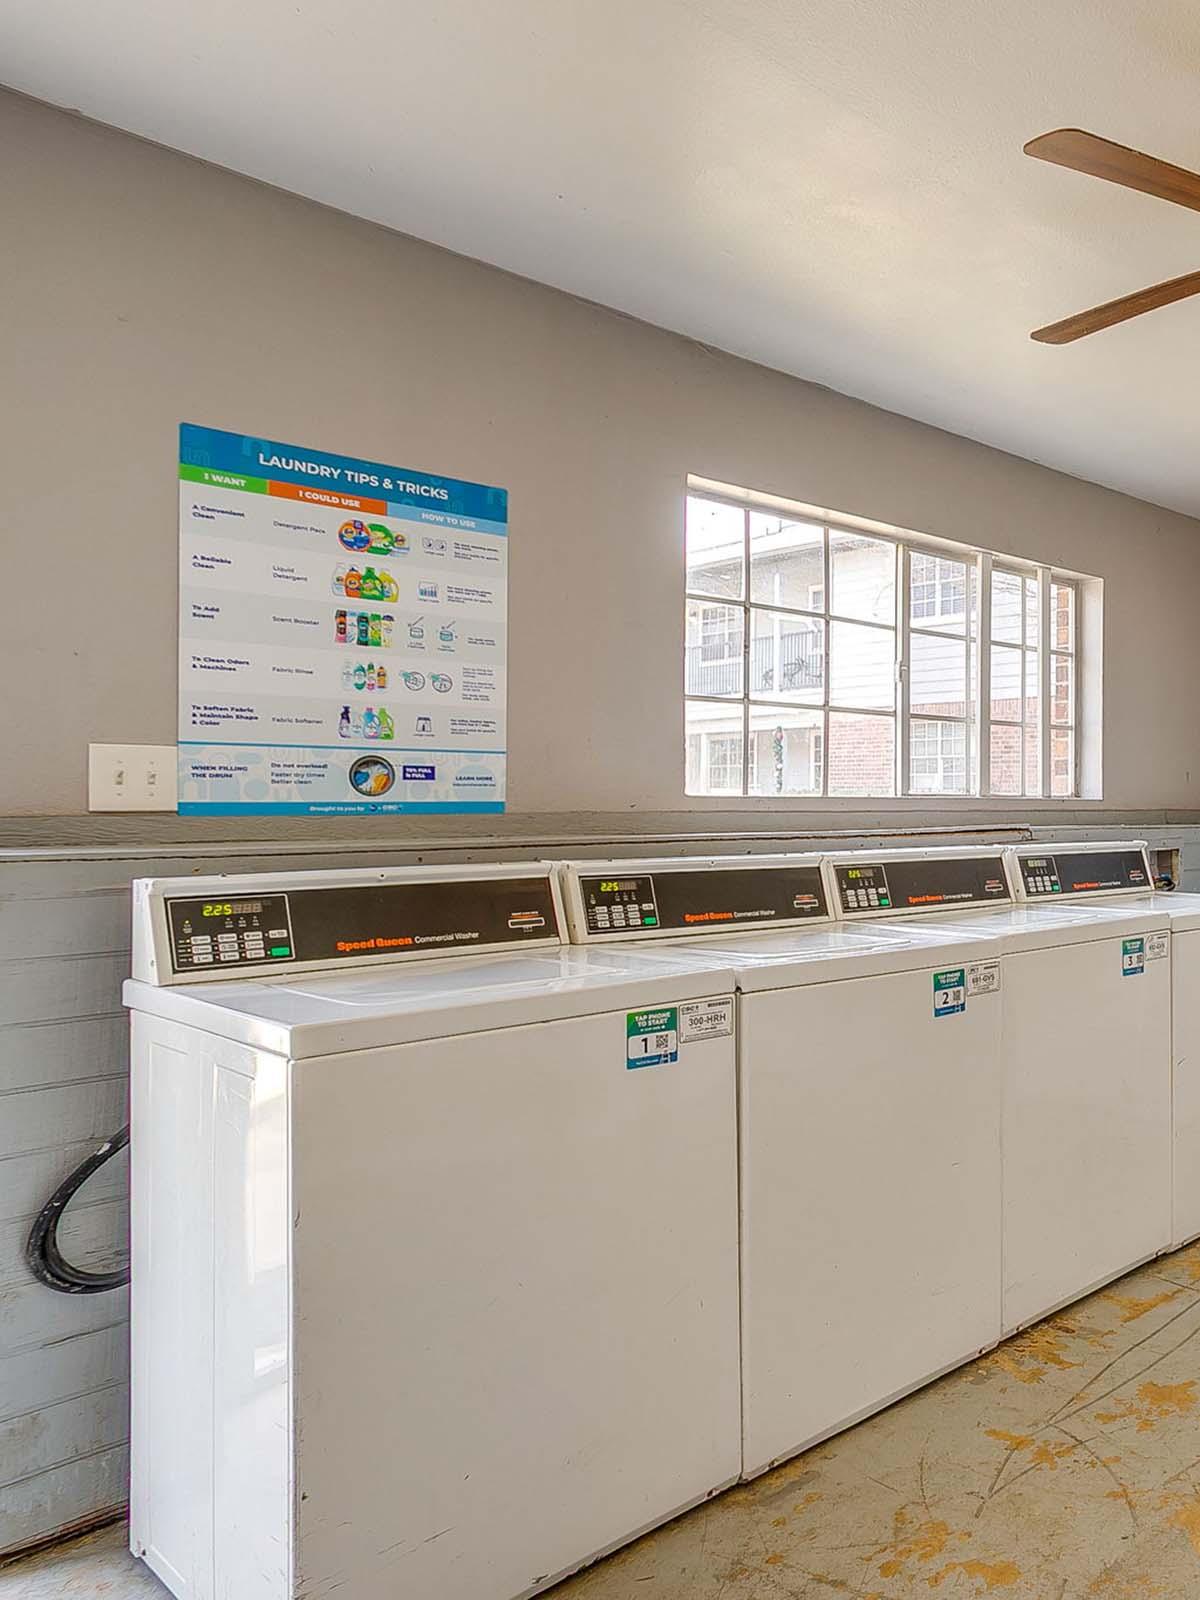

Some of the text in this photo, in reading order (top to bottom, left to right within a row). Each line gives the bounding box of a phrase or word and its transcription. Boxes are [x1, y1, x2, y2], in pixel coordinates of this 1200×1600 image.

[211, 474, 247, 487] WANT
[259, 453, 448, 500] LAUNDRY TIPS & TRICKS
[305, 491, 340, 503] COULD
[200, 506, 244, 517] Convenient
[422, 512, 476, 528] HOW TO USE
[273, 521, 308, 532] Detergent
[200, 556, 232, 564] Reliable
[202, 904, 232, 916] 2.25
[685, 913, 709, 922] Speed
[710, 912, 733, 921] Queen
[336, 932, 480, 951] Speed Queen Commercial Washer
[1128, 956, 1132, 966] 3
[942, 992, 949, 1005] 2
[648, 1012, 671, 1020] PHONE
[648, 1018, 668, 1026] START
[688, 1013, 726, 1026] 300-HRH
[641, 1037, 648, 1054] 1
